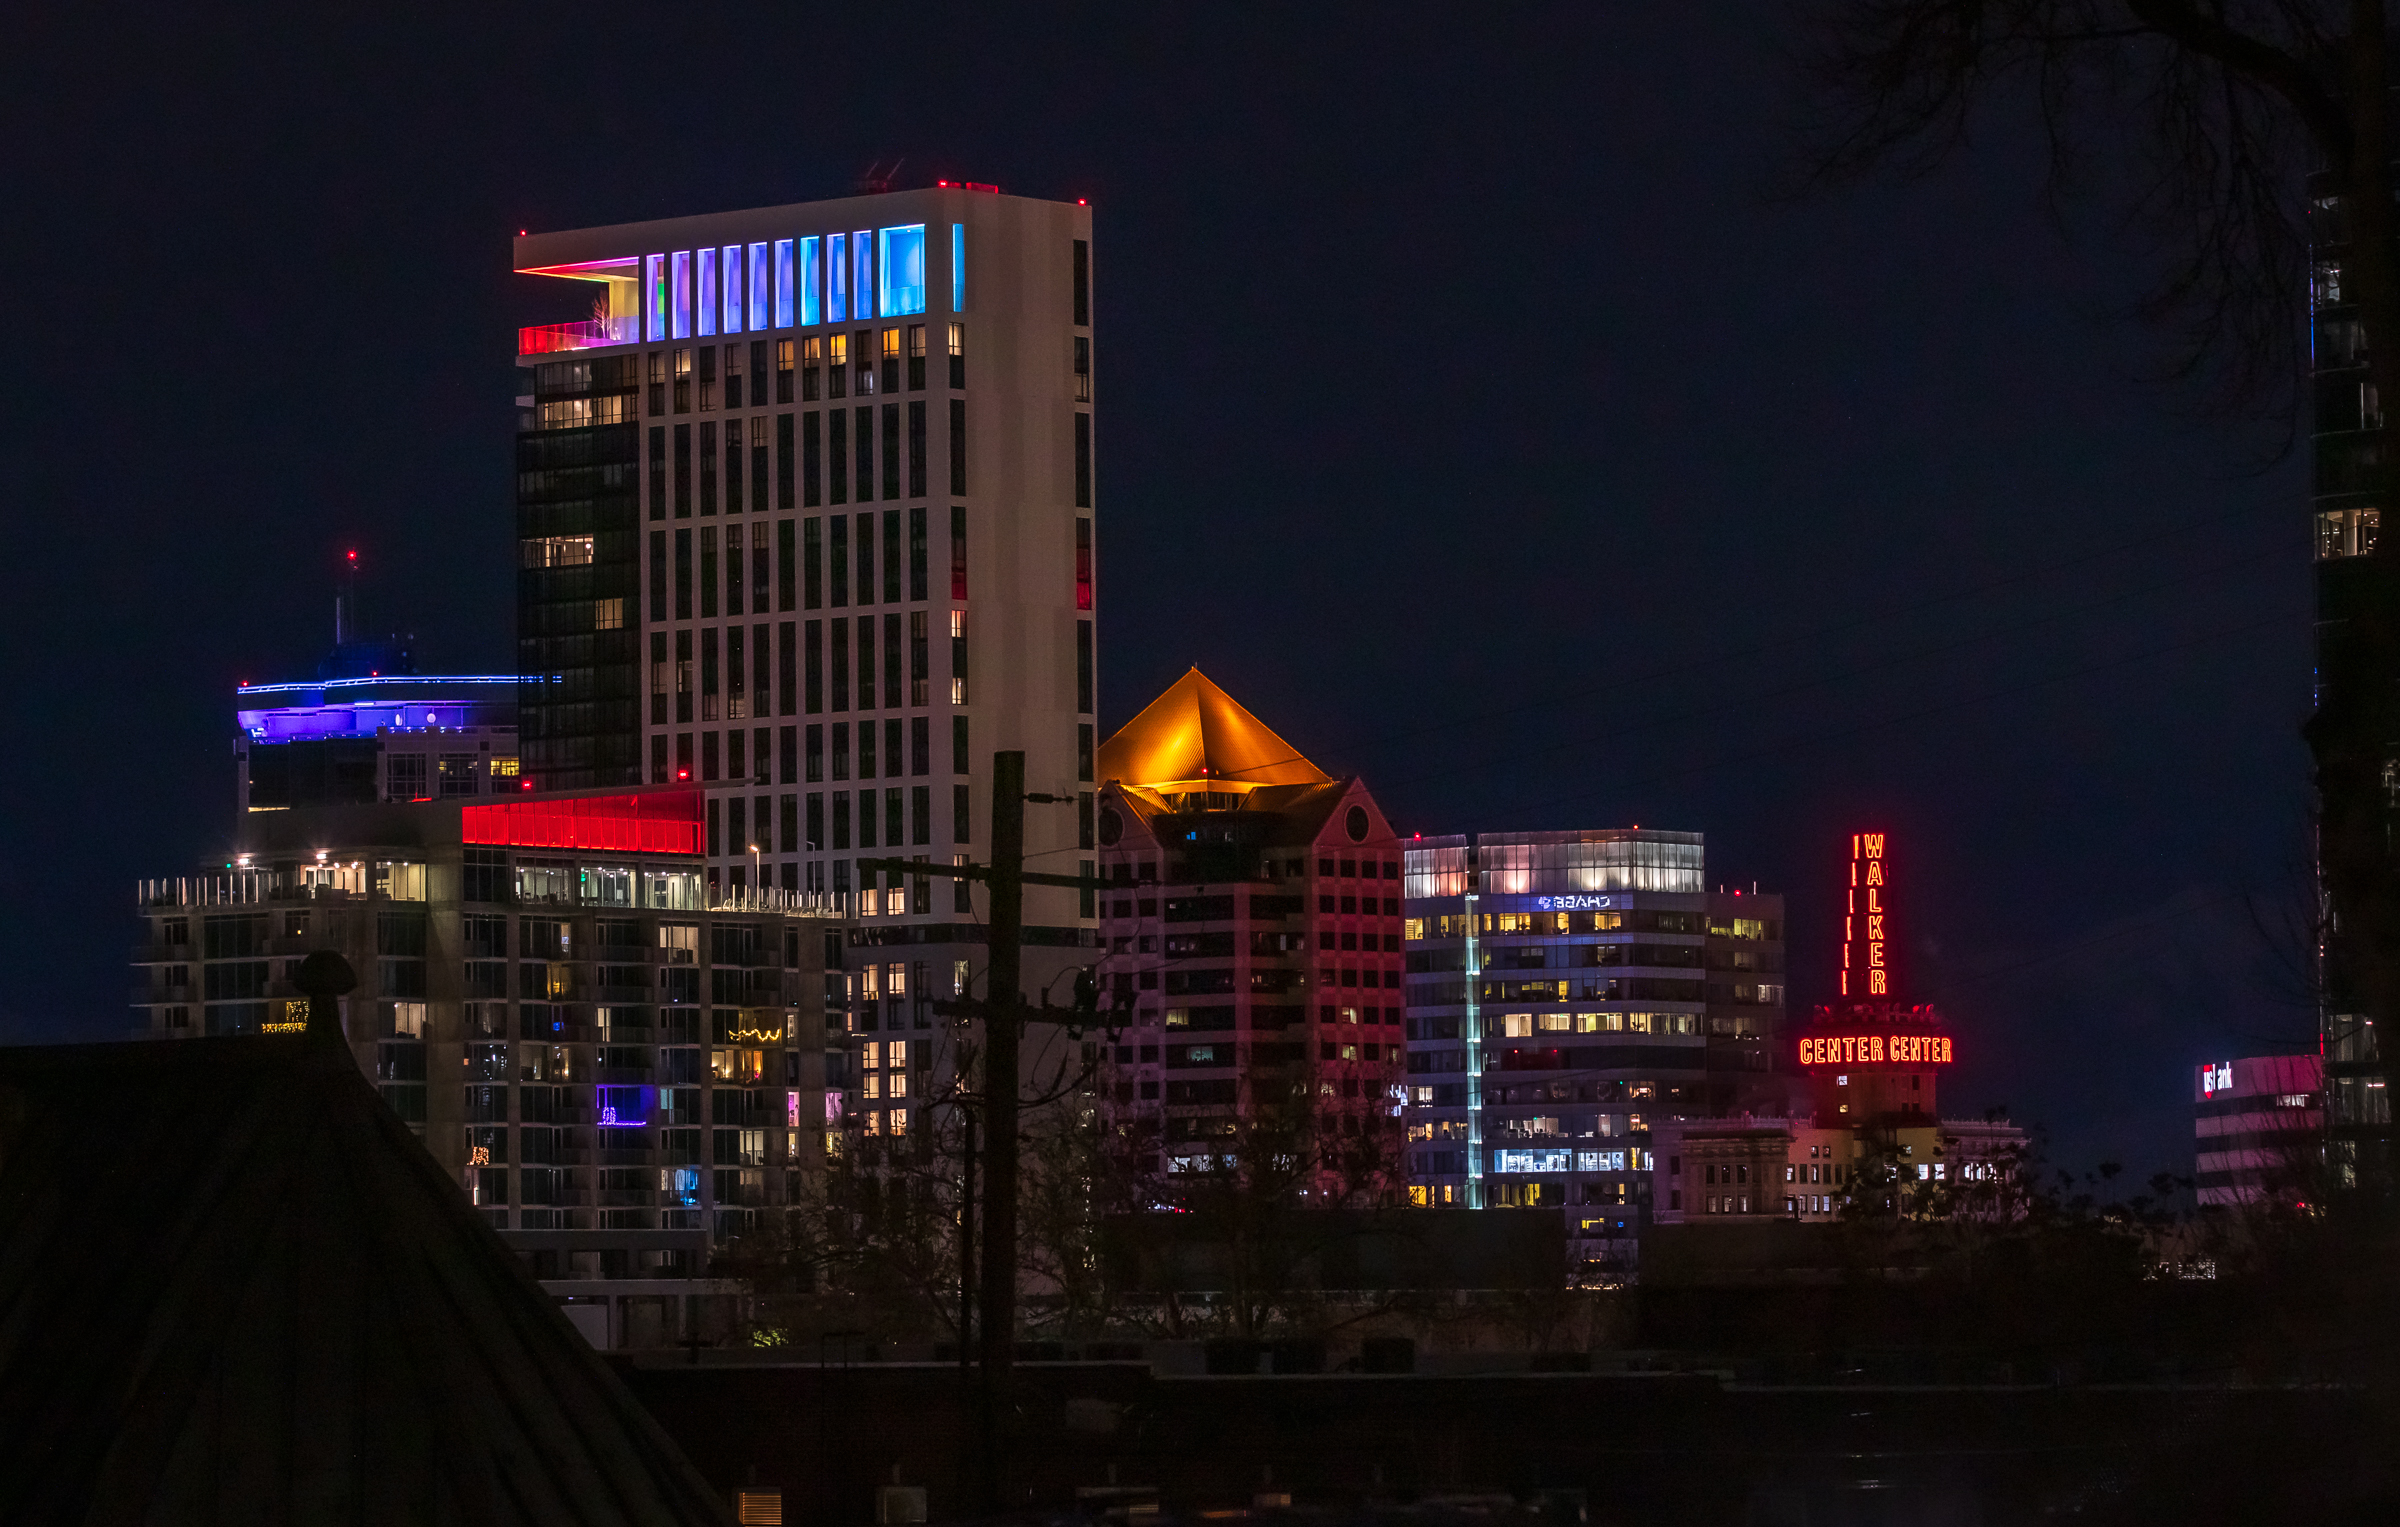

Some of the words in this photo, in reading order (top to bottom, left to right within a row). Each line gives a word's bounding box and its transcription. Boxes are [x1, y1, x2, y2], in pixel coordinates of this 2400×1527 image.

[1863, 833, 1887, 995] WALKER
[1800, 1036, 1884, 1064] CENTER
[1890, 1035, 1952, 1062] CENTER
